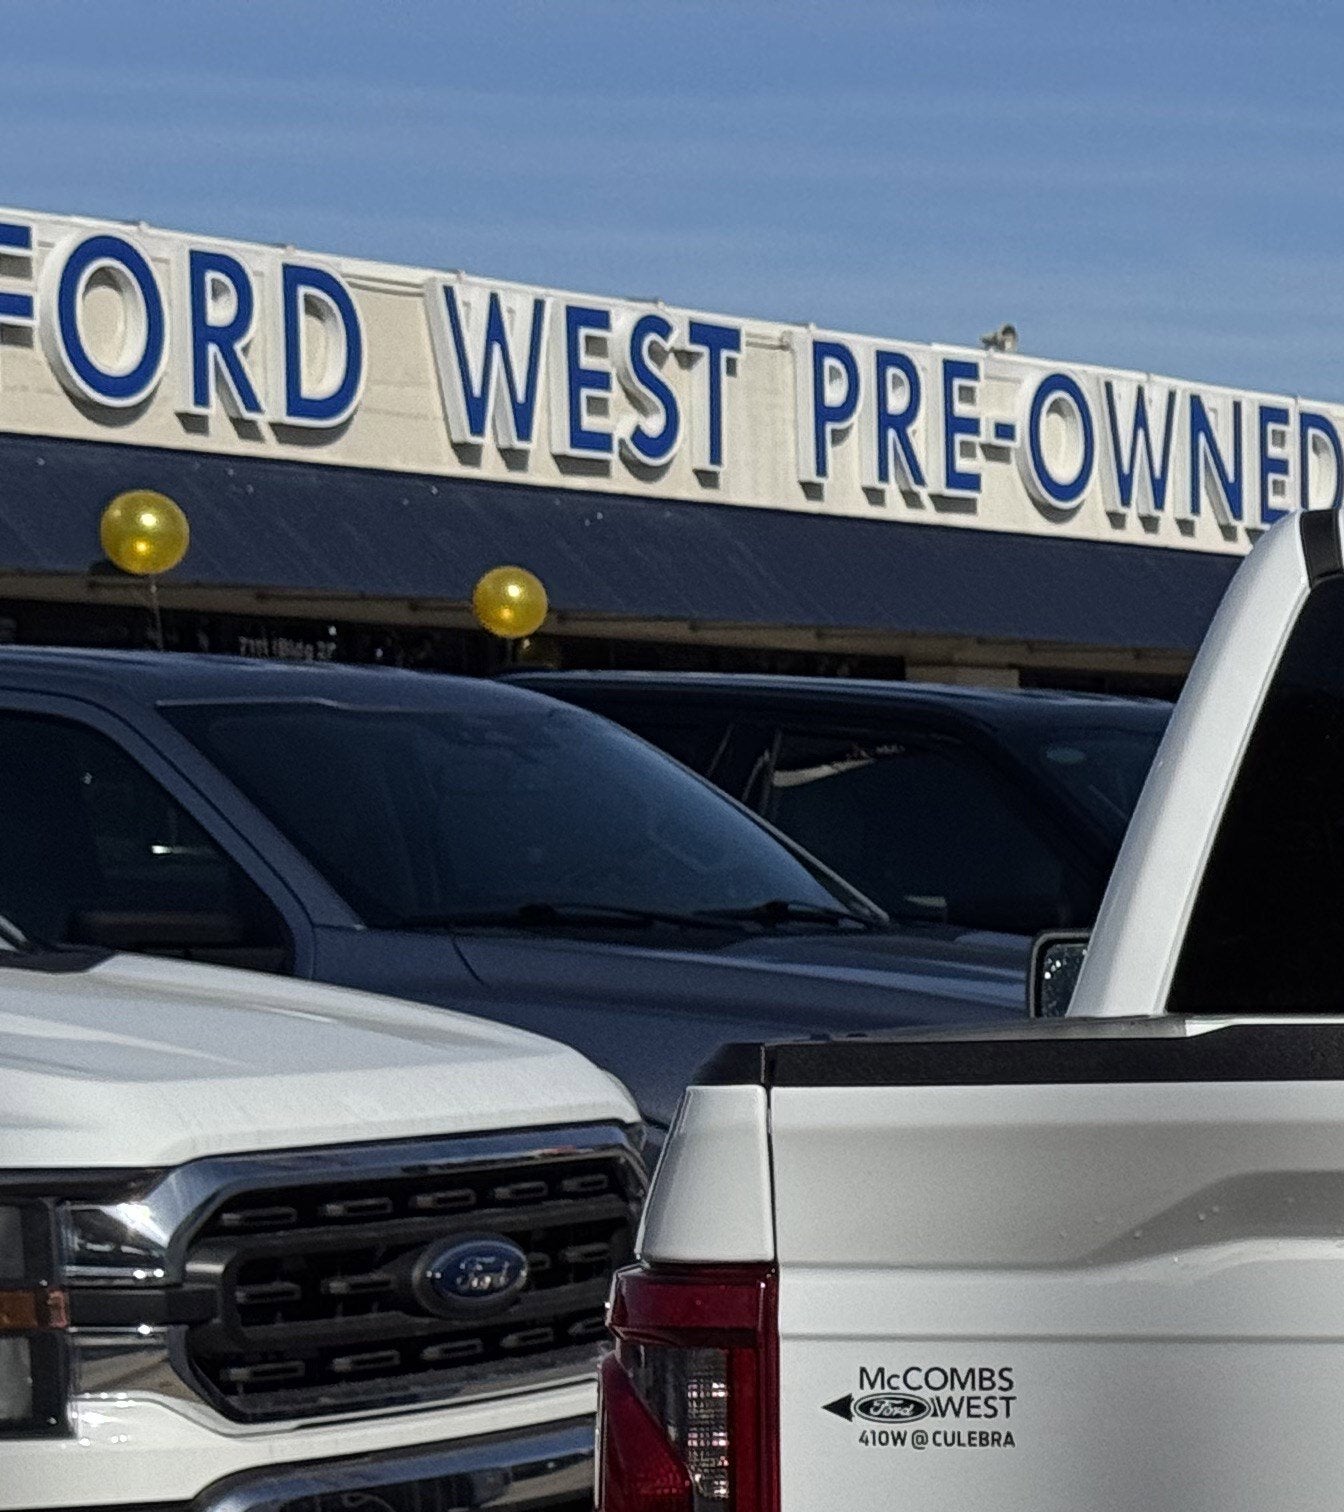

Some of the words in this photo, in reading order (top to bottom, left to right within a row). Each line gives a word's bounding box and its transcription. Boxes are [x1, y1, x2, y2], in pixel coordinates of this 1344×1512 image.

[438, 283, 743, 470] WEST
[858, 1366, 1015, 1392] McCOMBS
[868, 1399, 915, 1417] Ford
[934, 1395, 1017, 1419] WEST
